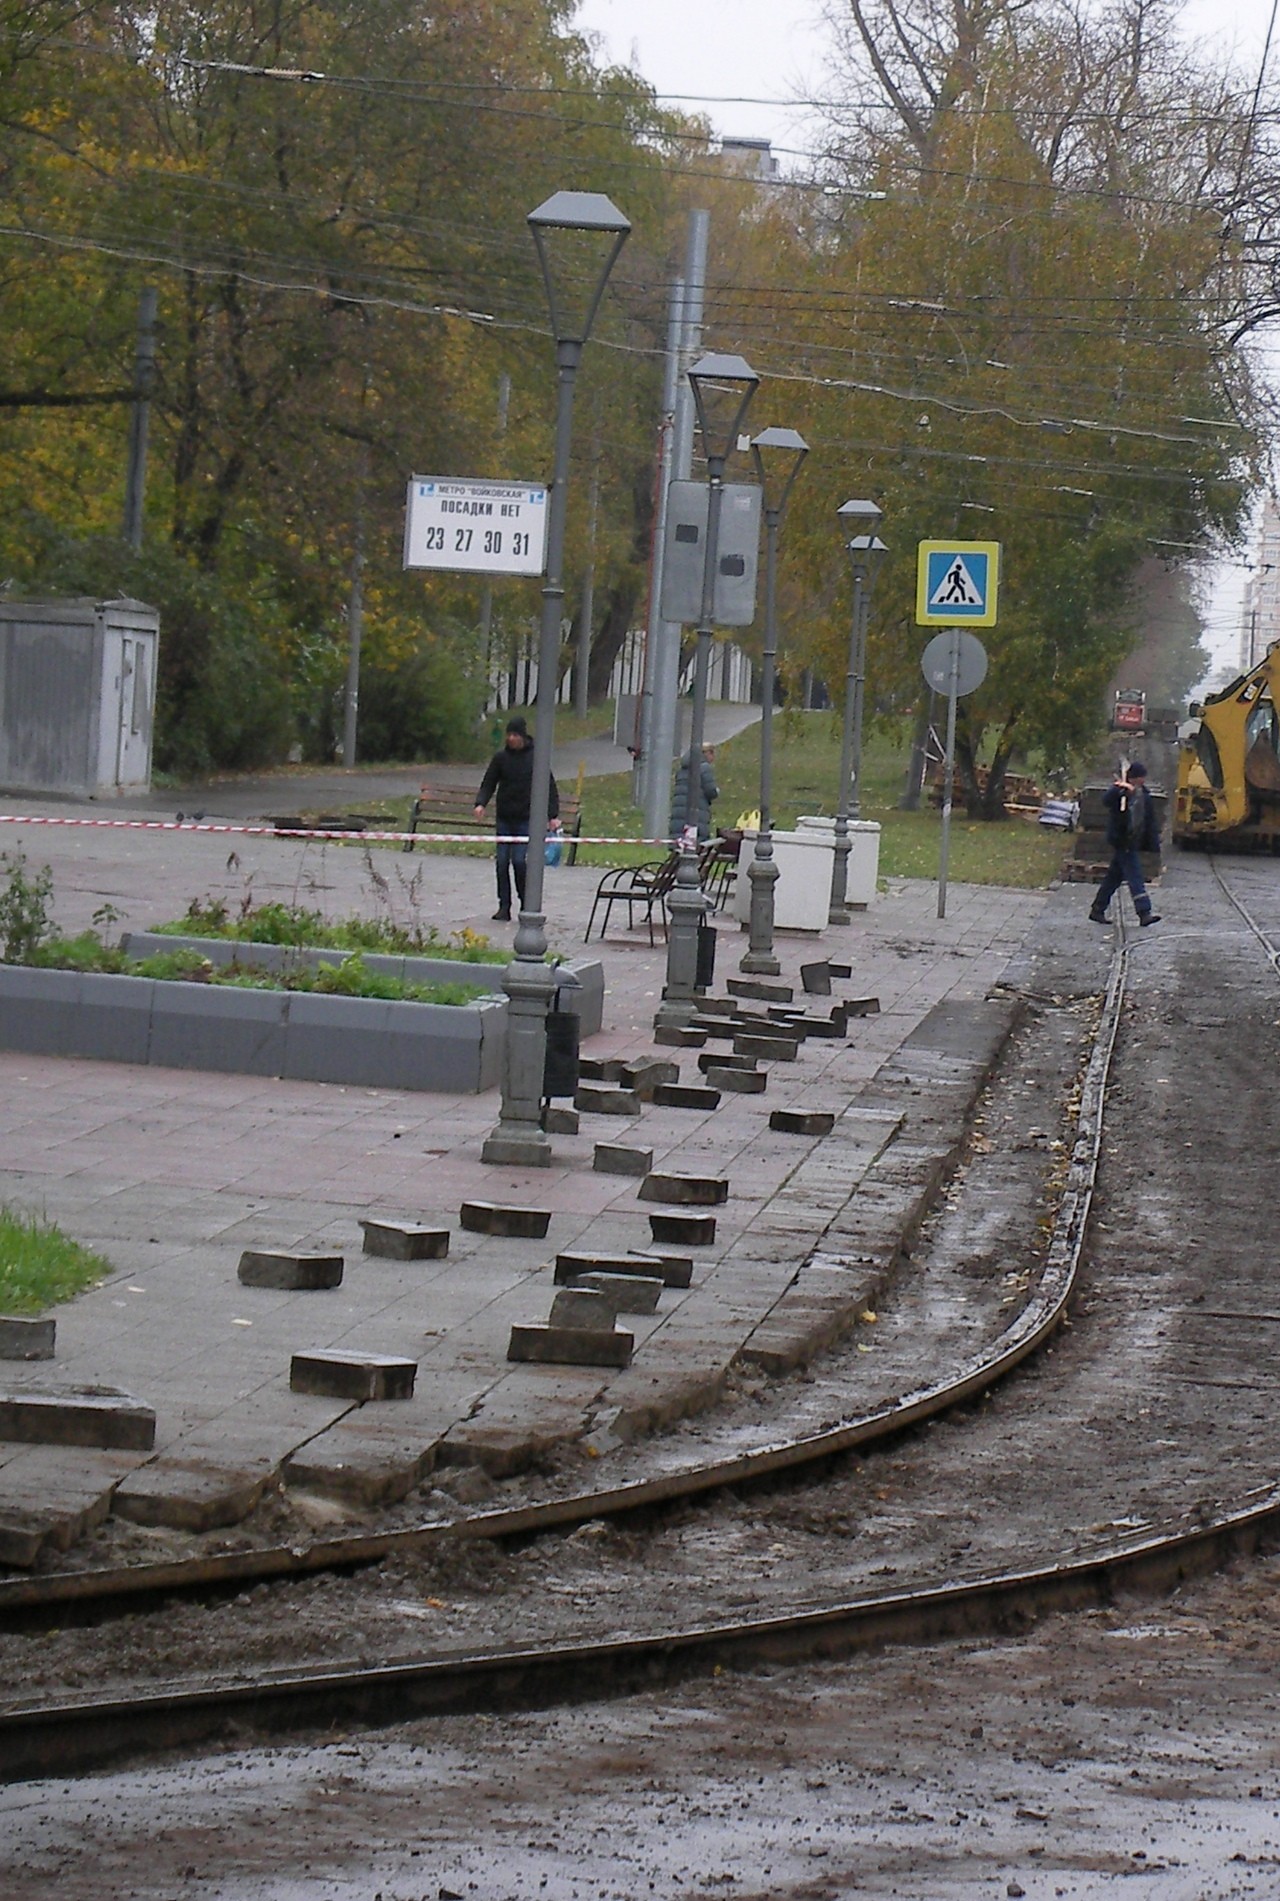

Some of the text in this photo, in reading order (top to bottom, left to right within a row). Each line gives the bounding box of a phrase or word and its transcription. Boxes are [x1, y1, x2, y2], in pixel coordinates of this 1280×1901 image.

[438, 485, 466, 495] МЕТРО
[441, 500, 520, 518] ПОСАДКИ НЕТ
[426, 526, 529, 556] 23 27 30 31
[1243, 683, 1258, 700] CAT
